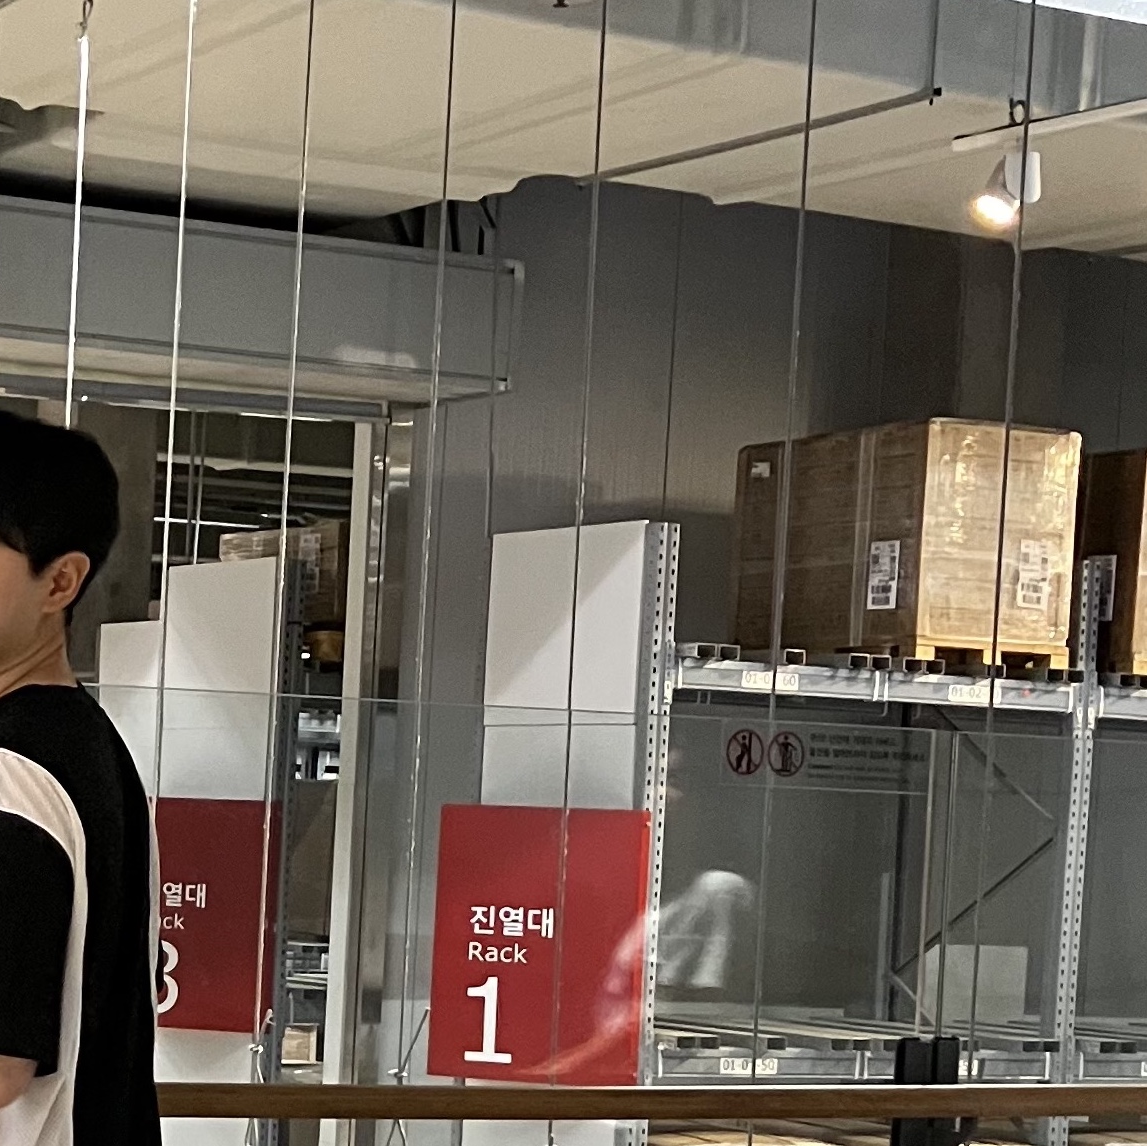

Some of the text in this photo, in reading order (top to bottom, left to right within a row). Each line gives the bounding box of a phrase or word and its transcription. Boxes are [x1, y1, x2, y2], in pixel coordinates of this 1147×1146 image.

[162, 882, 207, 909] 열대
[470, 905, 555, 939] 진열대
[468, 941, 528, 964] Rack
[464, 976, 513, 1064] 1
[723, 1059, 775, 1072] 01-0-50
